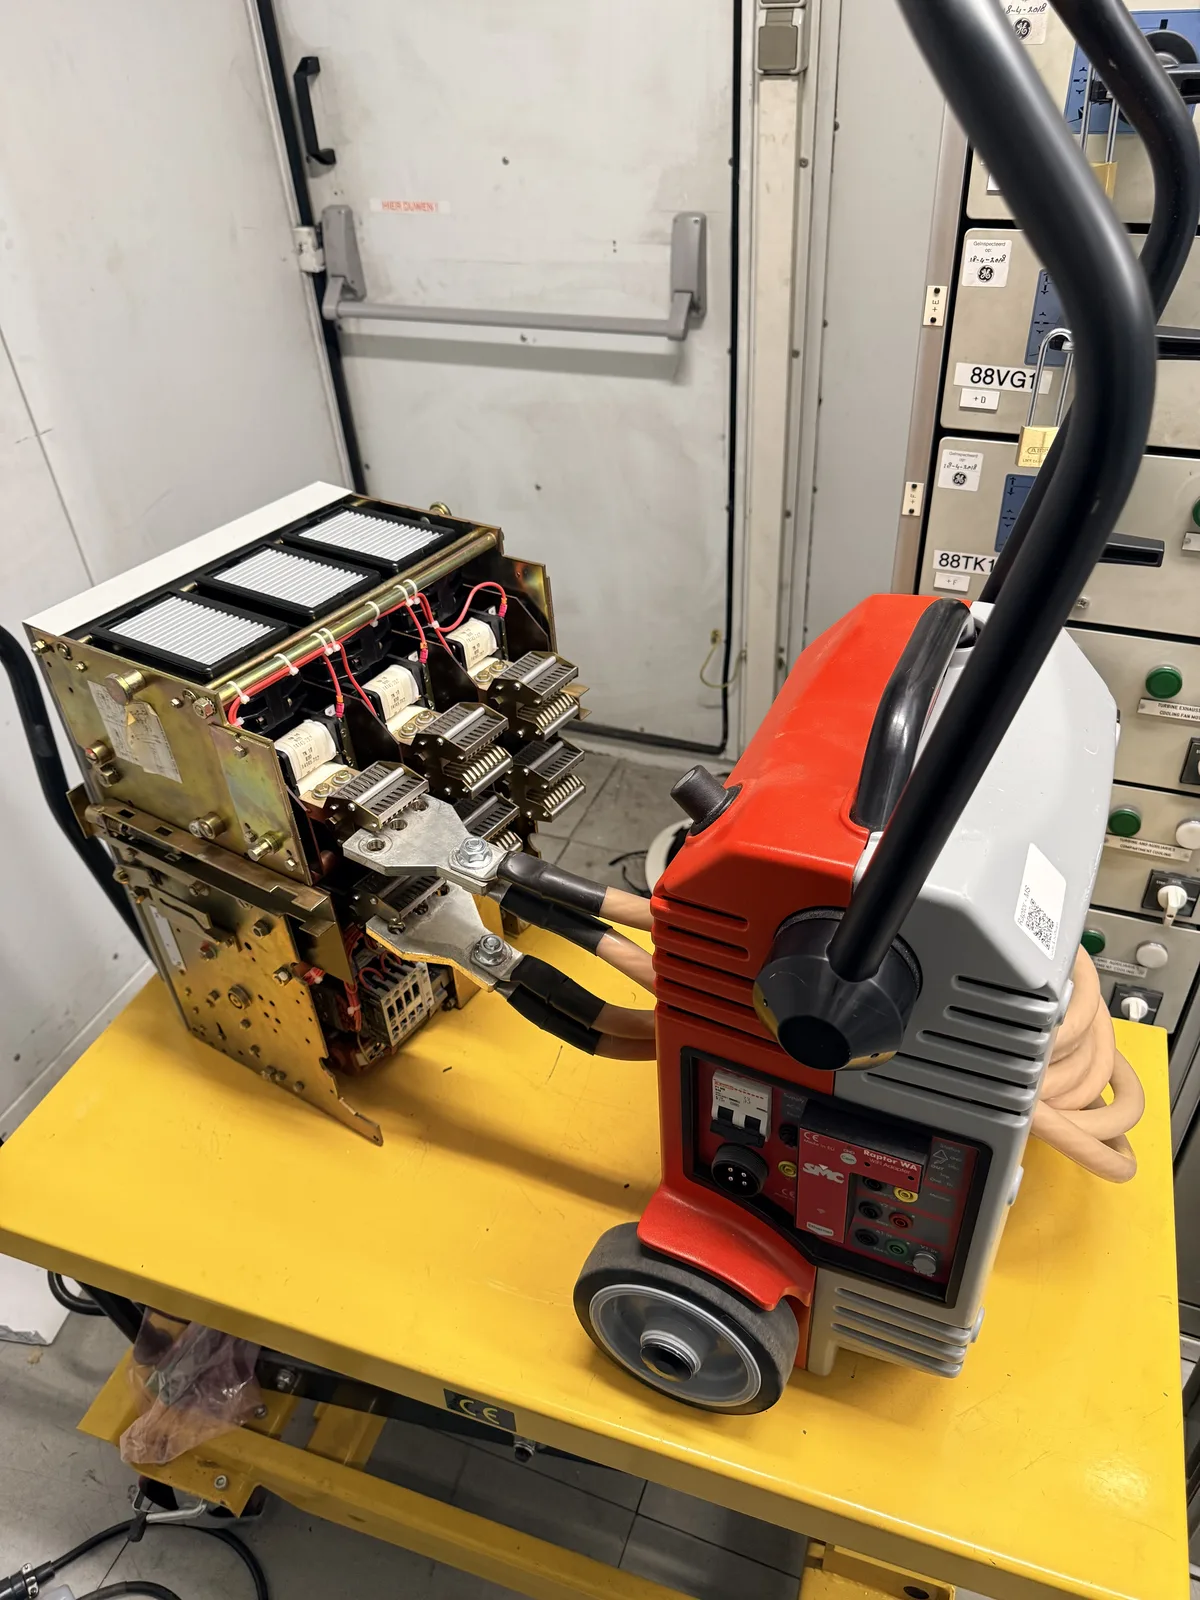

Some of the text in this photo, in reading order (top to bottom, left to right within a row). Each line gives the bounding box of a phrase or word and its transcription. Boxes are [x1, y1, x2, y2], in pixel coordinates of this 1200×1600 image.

[382, 200, 401, 211] HIER
[970, 367, 1036, 389] 88VG1
[939, 553, 995, 572] 88TK1
[863, 1149, 918, 1172] Raptor WA
[803, 1162, 844, 1184] SMC
[460, 1399, 500, 1425] CE
